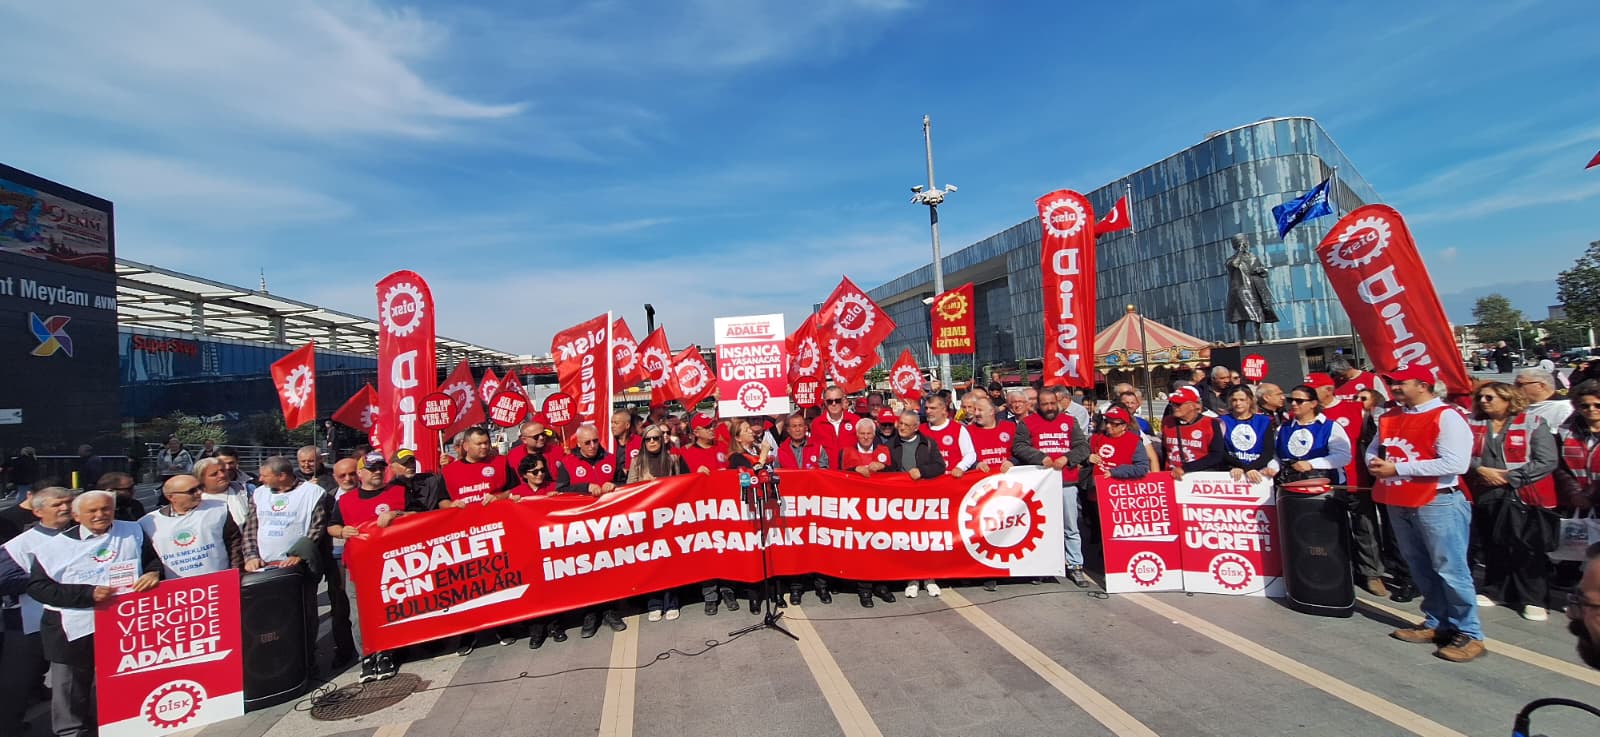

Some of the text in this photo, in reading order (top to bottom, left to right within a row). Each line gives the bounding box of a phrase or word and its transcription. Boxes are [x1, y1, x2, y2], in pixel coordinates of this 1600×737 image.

[20, 279, 89, 305] Meydanı
[94, 295, 117, 311] AVM
[726, 324, 771, 337] ADALET
[720, 344, 781, 359] İNSANCA
[721, 362, 782, 381] ÜCRET!
[1191, 483, 1253, 495] ADALET
[539, 511, 647, 550] HAYAT
[780, 496, 862, 520] EMEK
[866, 497, 950, 520] UCUZ!
[1112, 509, 1170, 524] ÜLKEDE
[1182, 504, 1270, 523] İNSANCA
[469, 521, 504, 537] ÜLKEDE
[1113, 522, 1171, 537] ADALET
[1185, 526, 1271, 552] ÜCRET!
[380, 529, 506, 584] ADALET
[543, 522, 953, 581] İNSANCA YAŞAMAK İSTİYORUZ!
[385, 570, 523, 622] BULUŞMALARI
[119, 618, 221, 653] ÜLKEDE
[116, 635, 221, 673] ADALET
